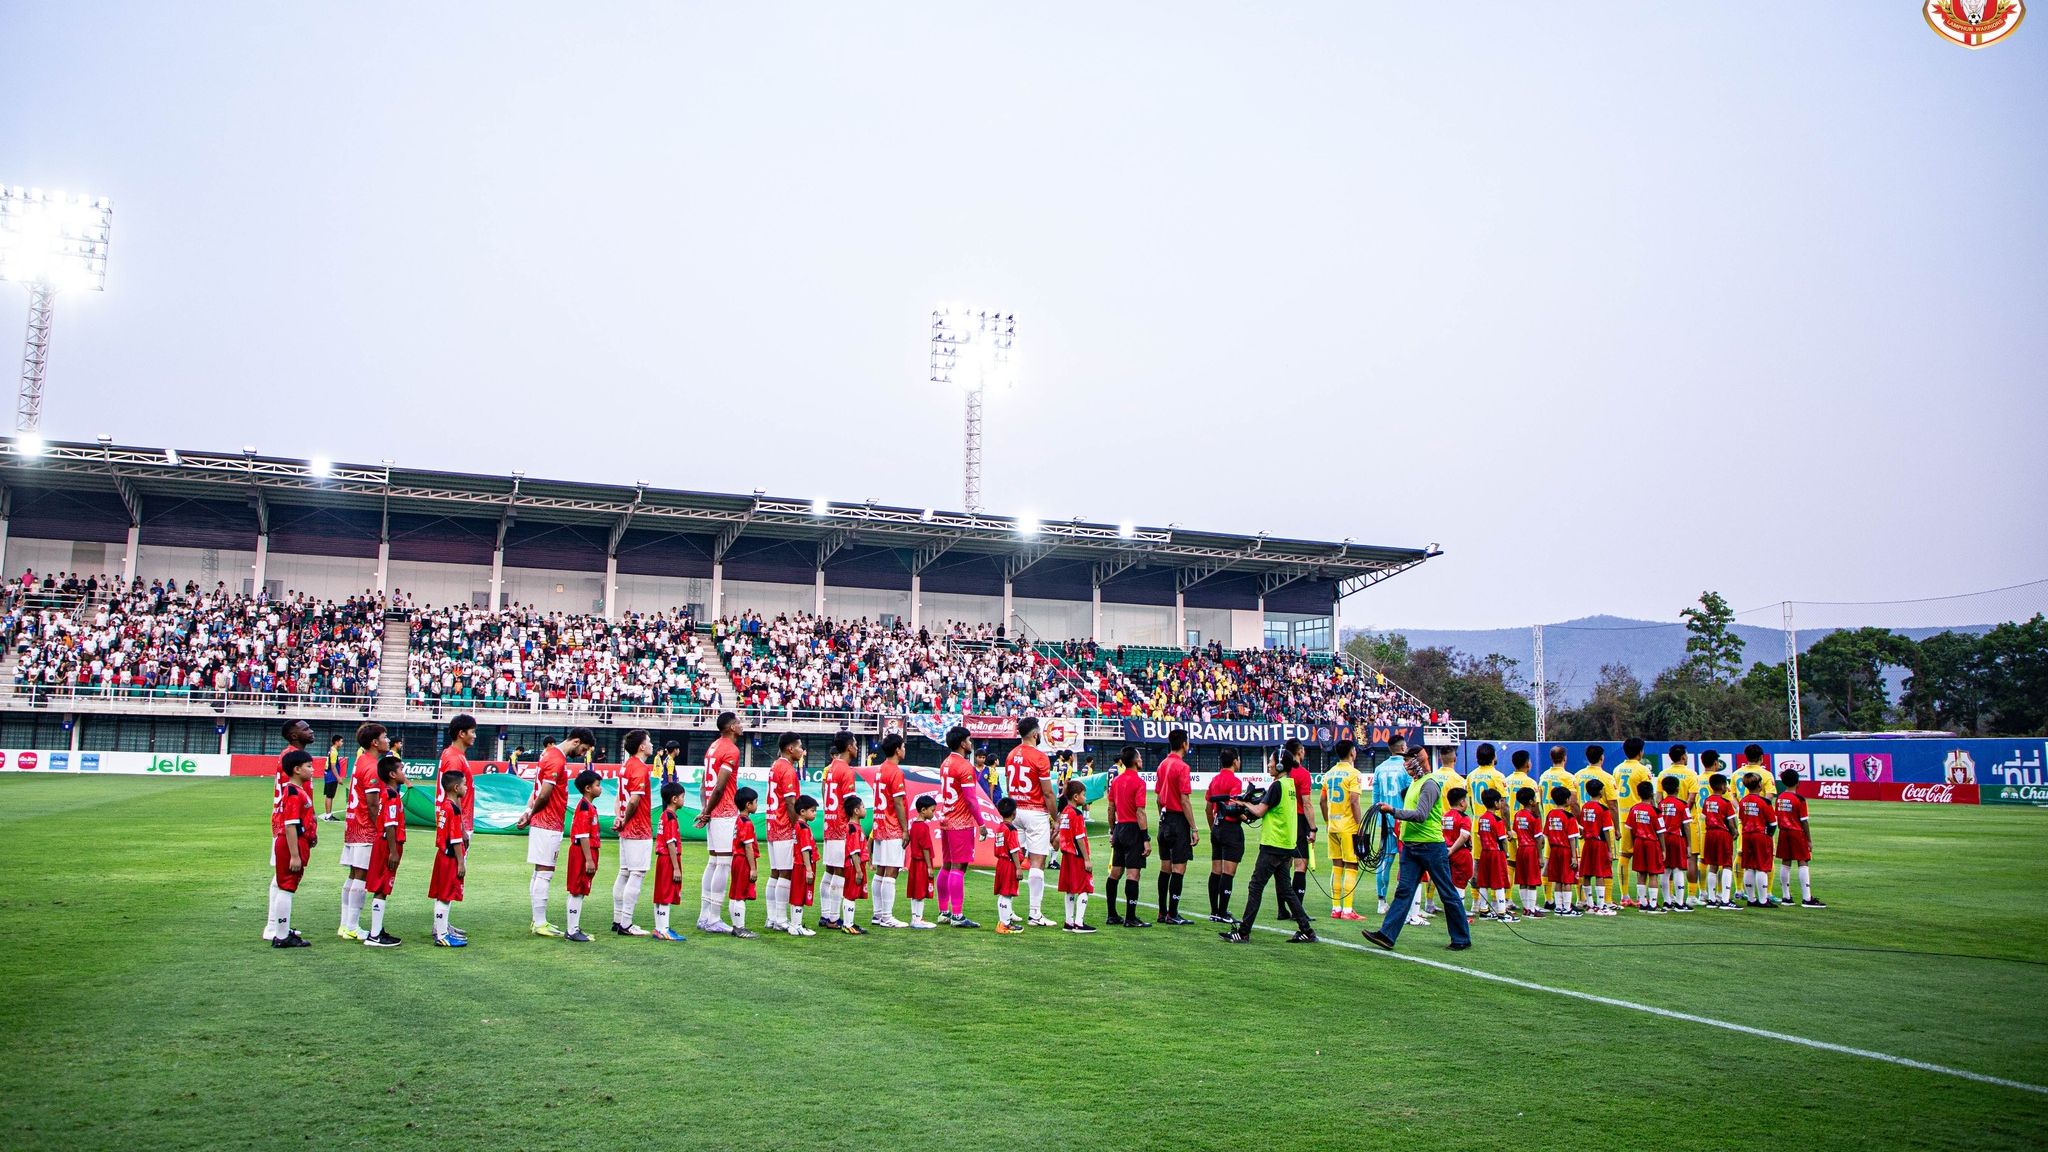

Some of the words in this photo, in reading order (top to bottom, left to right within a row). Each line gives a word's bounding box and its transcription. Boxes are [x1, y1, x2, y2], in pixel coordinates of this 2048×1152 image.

[147, 755, 197, 773] Jele
[400, 761, 436, 777] hang
[1818, 764, 1847, 778] Jele
[1007, 765, 1032, 793] 2.5
[1618, 775, 1631, 798] 3
[1327, 777, 1345, 803] 15
[1818, 781, 1849, 797] jetts
[1902, 783, 1956, 803] Coca-Cola
